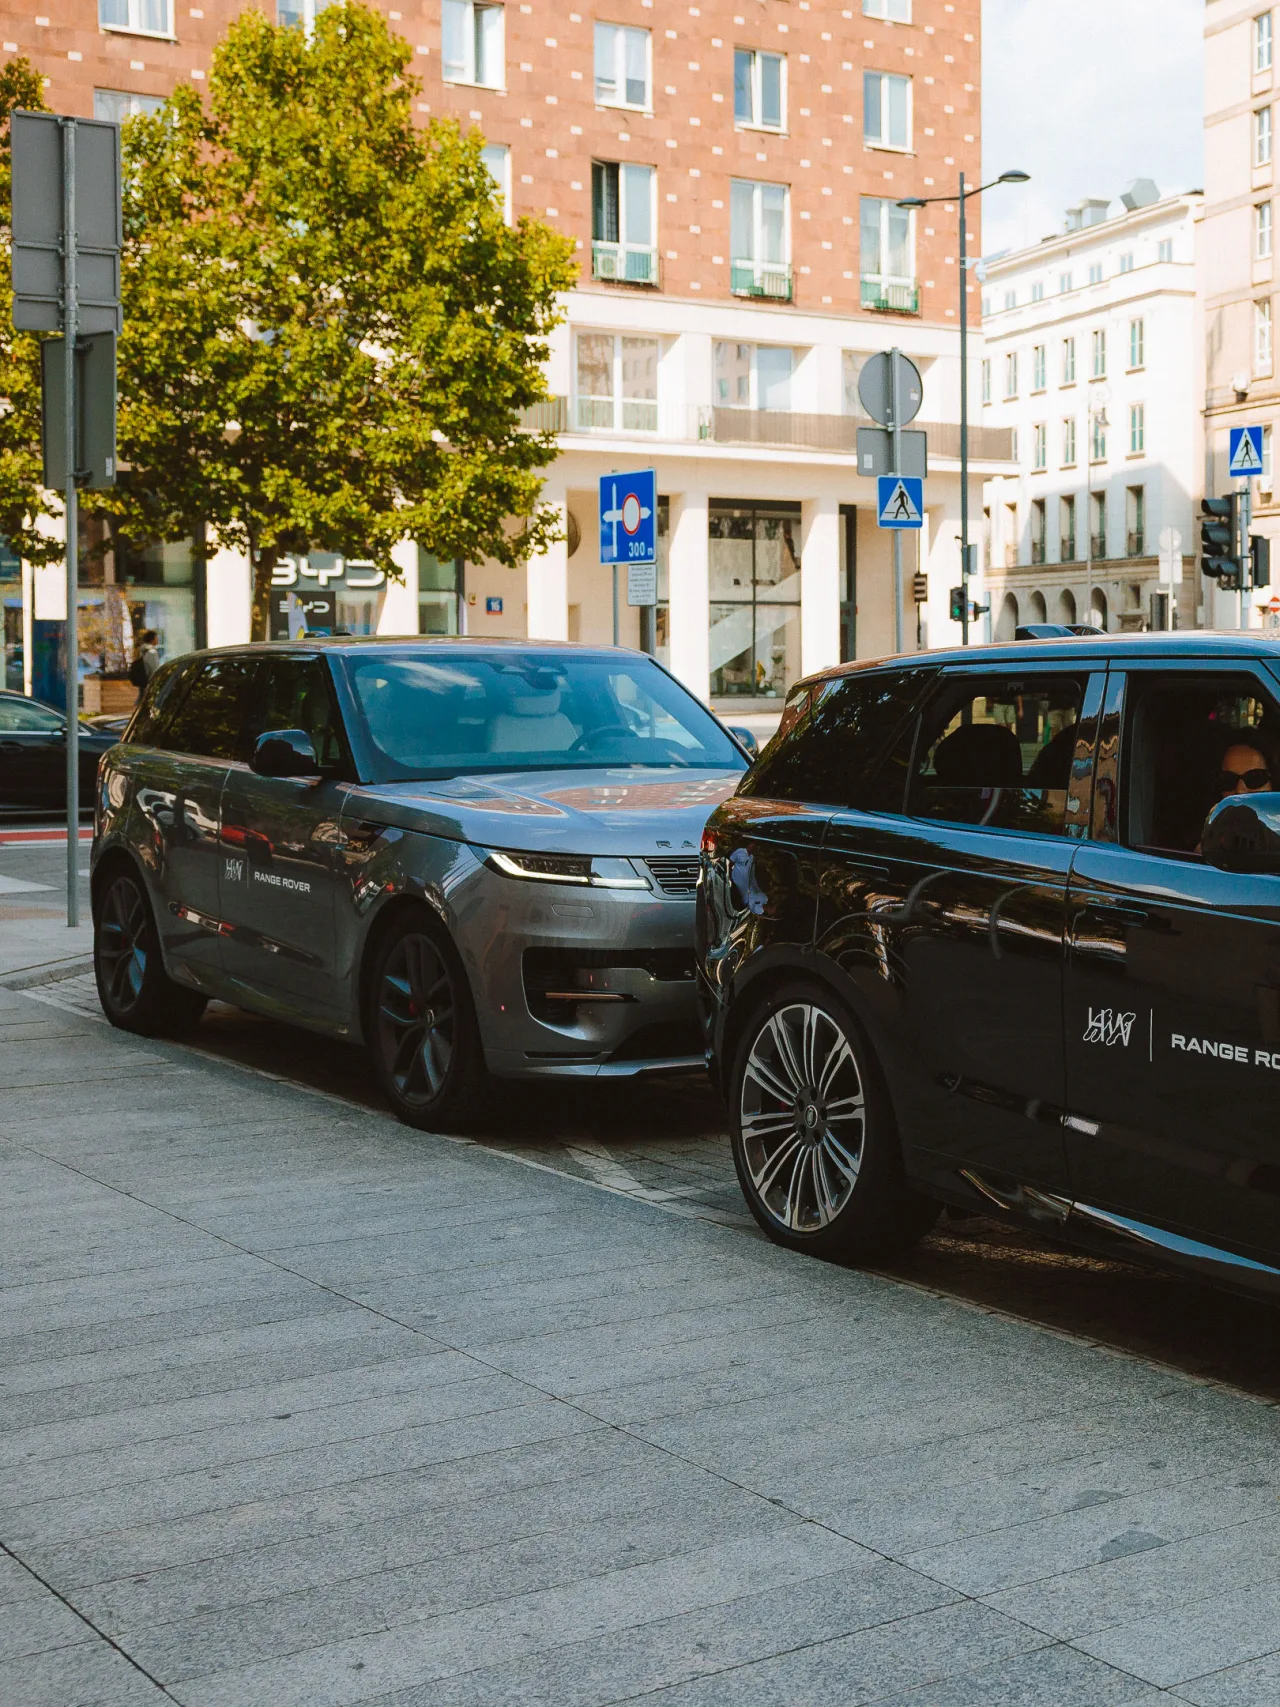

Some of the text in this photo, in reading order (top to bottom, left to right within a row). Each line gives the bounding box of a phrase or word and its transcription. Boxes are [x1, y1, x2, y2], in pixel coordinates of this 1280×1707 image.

[628, 541, 645, 557] 300
[270, 556, 386, 588] BYD
[254, 871, 311, 893] RANGE ROVER
[1171, 1033, 1249, 1063] RANGE
